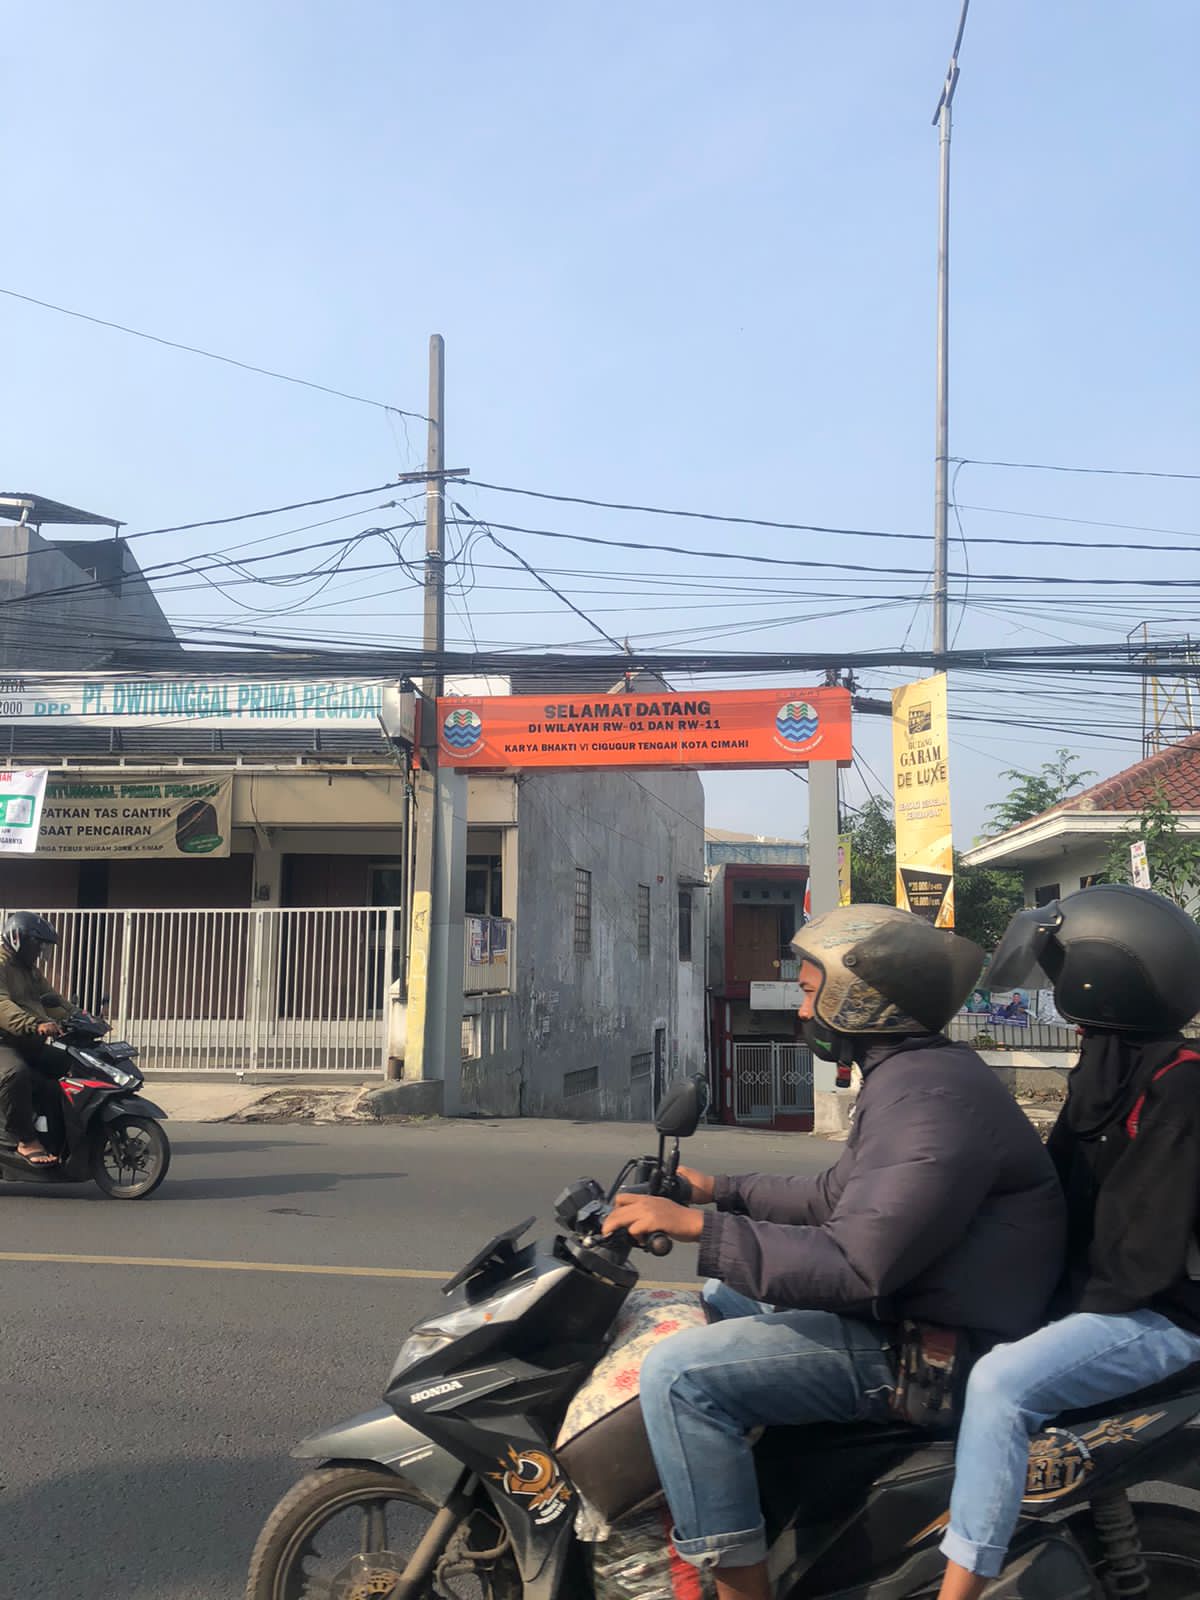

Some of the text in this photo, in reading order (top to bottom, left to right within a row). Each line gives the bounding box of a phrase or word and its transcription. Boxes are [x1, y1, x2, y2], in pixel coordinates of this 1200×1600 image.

[34, 701, 72, 715] DPP
[113, 682, 233, 718] DWITUNGGAL
[238, 684, 298, 719] PRIMA
[544, 701, 711, 719] SELAMAT DATANG
[528, 724, 541, 733] DI
[545, 723, 599, 733] WILAYAH
[648, 721, 674, 730] DAN
[678, 720, 721, 730] RW-11
[504, 744, 538, 752] KARYA
[541, 743, 577, 751] BHAKTI
[638, 742, 678, 750] TENGAH
[681, 741, 708, 749] KOTA
[711, 740, 749, 748] CIMAHI
[900, 746, 941, 767] GARAM
[897, 764, 947, 788] DE LUXE
[94, 808, 118, 818] TAS
[122, 808, 171, 818] CANTIK
[40, 825, 152, 835] SAAT PENCAIRAN
[410, 1381, 462, 1404] HONDA
